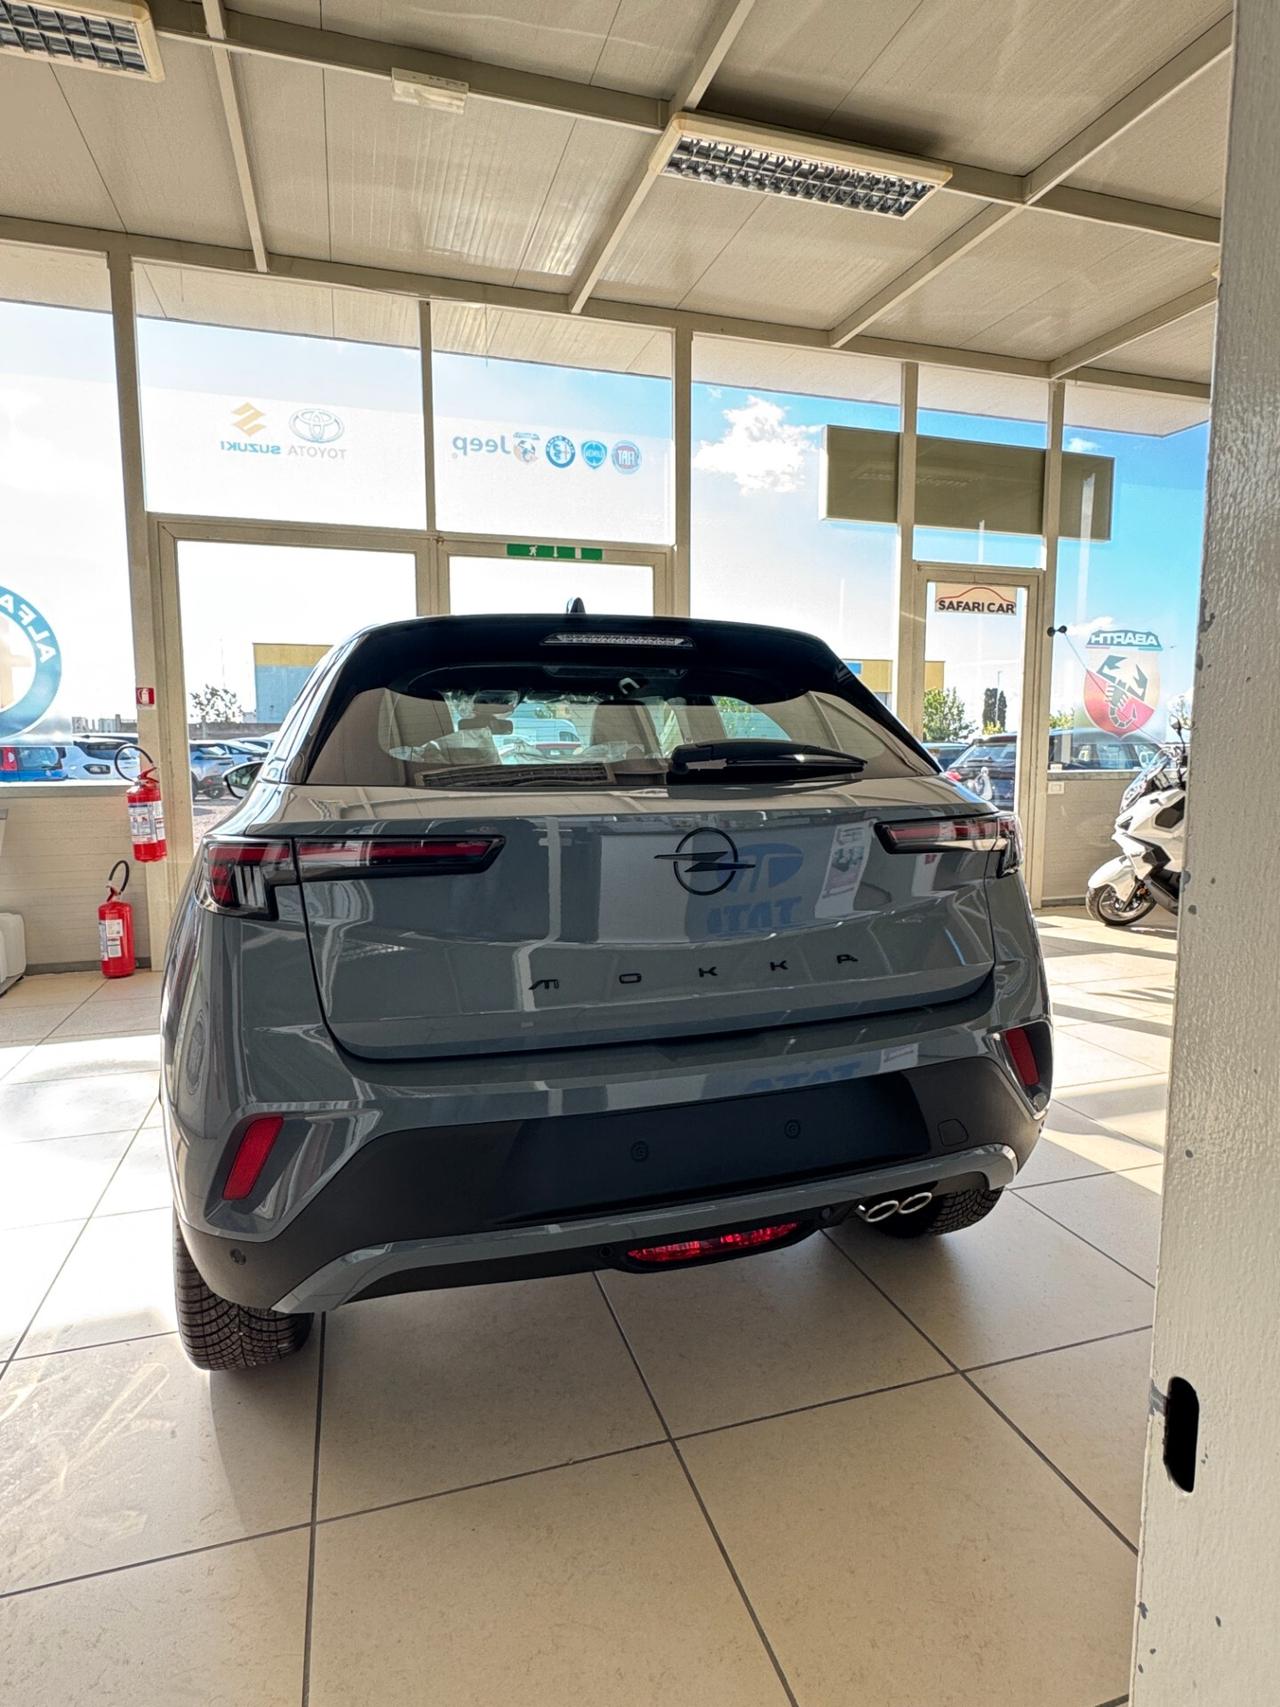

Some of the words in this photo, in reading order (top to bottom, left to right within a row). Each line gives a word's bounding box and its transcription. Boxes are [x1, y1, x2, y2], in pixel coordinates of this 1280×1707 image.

[938, 600, 985, 612] SAFARI
[987, 602, 1015, 613] CAR
[529, 953, 858, 990] MOKKA
